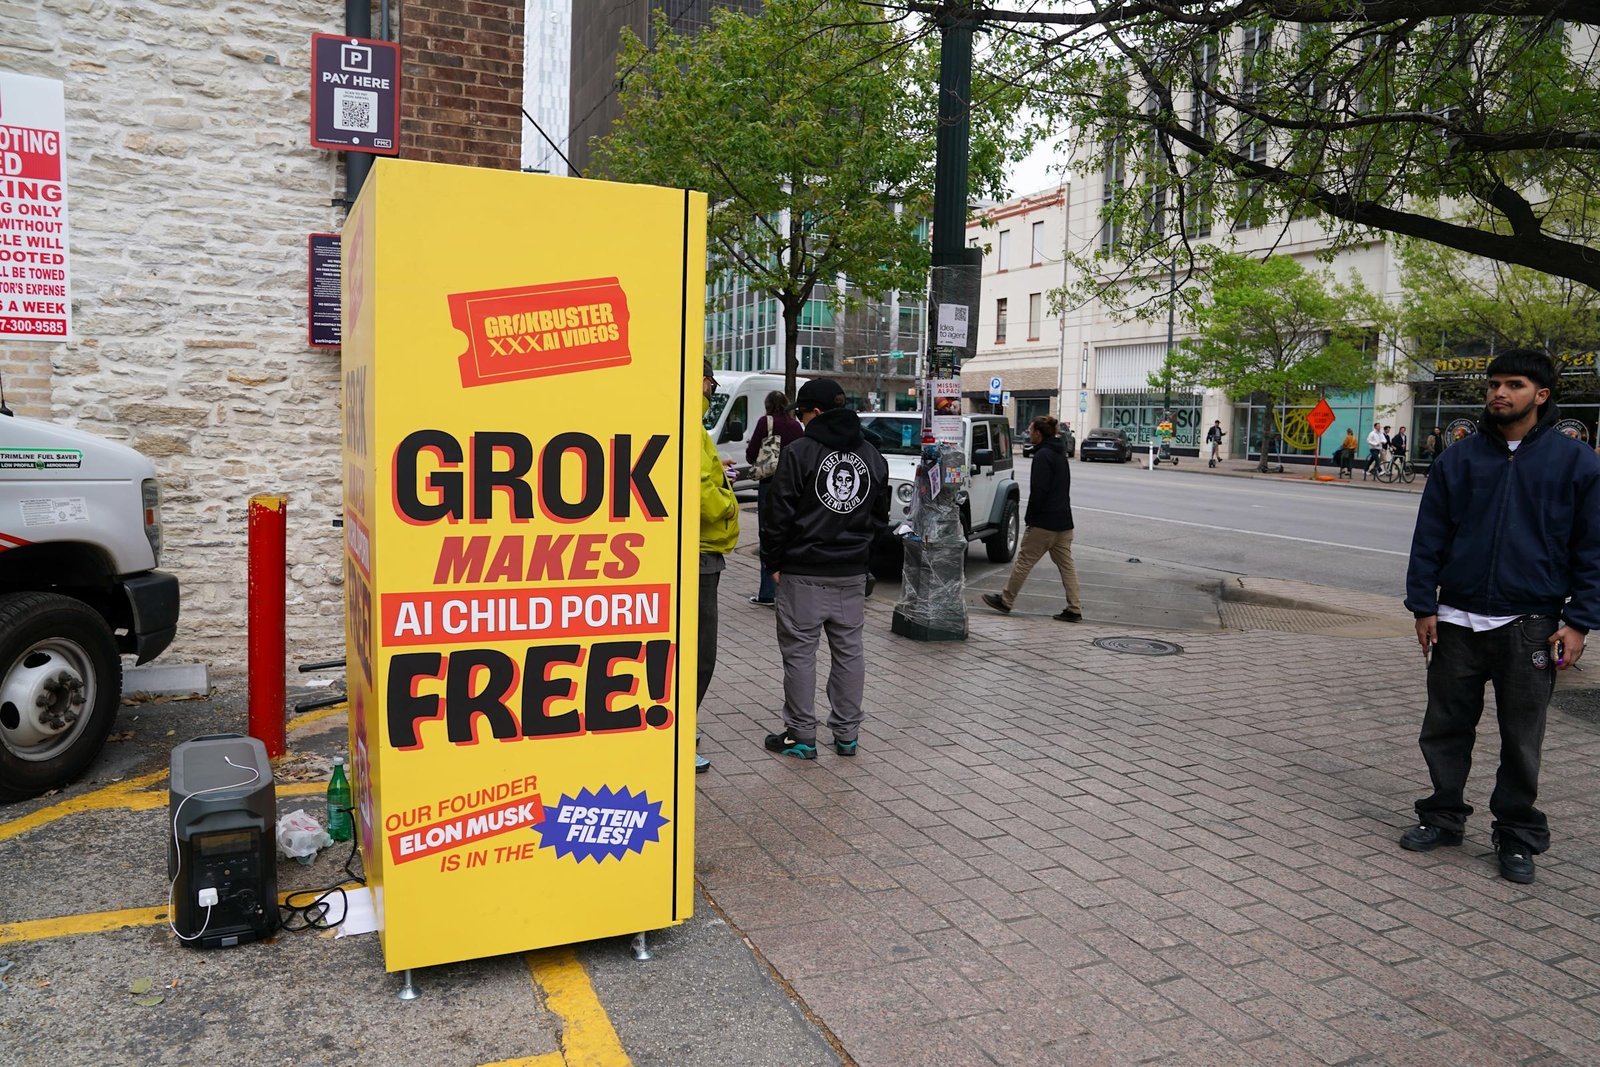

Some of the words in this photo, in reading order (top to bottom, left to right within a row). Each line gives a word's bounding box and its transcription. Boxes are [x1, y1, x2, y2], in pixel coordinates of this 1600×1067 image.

[322, 71, 349, 85] PAY
[352, 75, 390, 90] HERE
[18, 203, 62, 218] ONLY
[0, 217, 63, 234] WITHOUT
[0, 234, 22, 246] LE
[26, 236, 64, 250] WILL
[12, 266, 26, 279] BE
[28, 267, 65, 281] TOWED
[26, 283, 66, 297] EXPENSE
[8, 300, 18, 313] A
[22, 301, 66, 314] WEEK
[0, 319, 64, 333] 7-300-9585
[562, 323, 620, 348] VIDEOS
[947, 332, 966, 340] agent
[821, 453, 840, 473] OBEY
[841, 453, 867, 475] MISFITS
[391, 429, 671, 527] GROK
[821, 492, 843, 511] FIEND
[844, 495, 861, 511] CLUB
[433, 532, 645, 585] MAKES
[393, 601, 433, 637] AI
[442, 597, 553, 633] CHILD
[560, 592, 659, 629] PORN
[387, 639, 676, 752] FREE!
[385, 805, 432, 832] OUR
[437, 775, 538, 817] FOUNDER
[556, 805, 649, 829] EPSTEIN
[399, 822, 463, 857] ELON
[465, 801, 535, 839] MUSK
[565, 825, 634, 846] FILES!
[440, 854, 461, 873] IS
[466, 850, 488, 869] IN
[493, 842, 536, 864] THE
